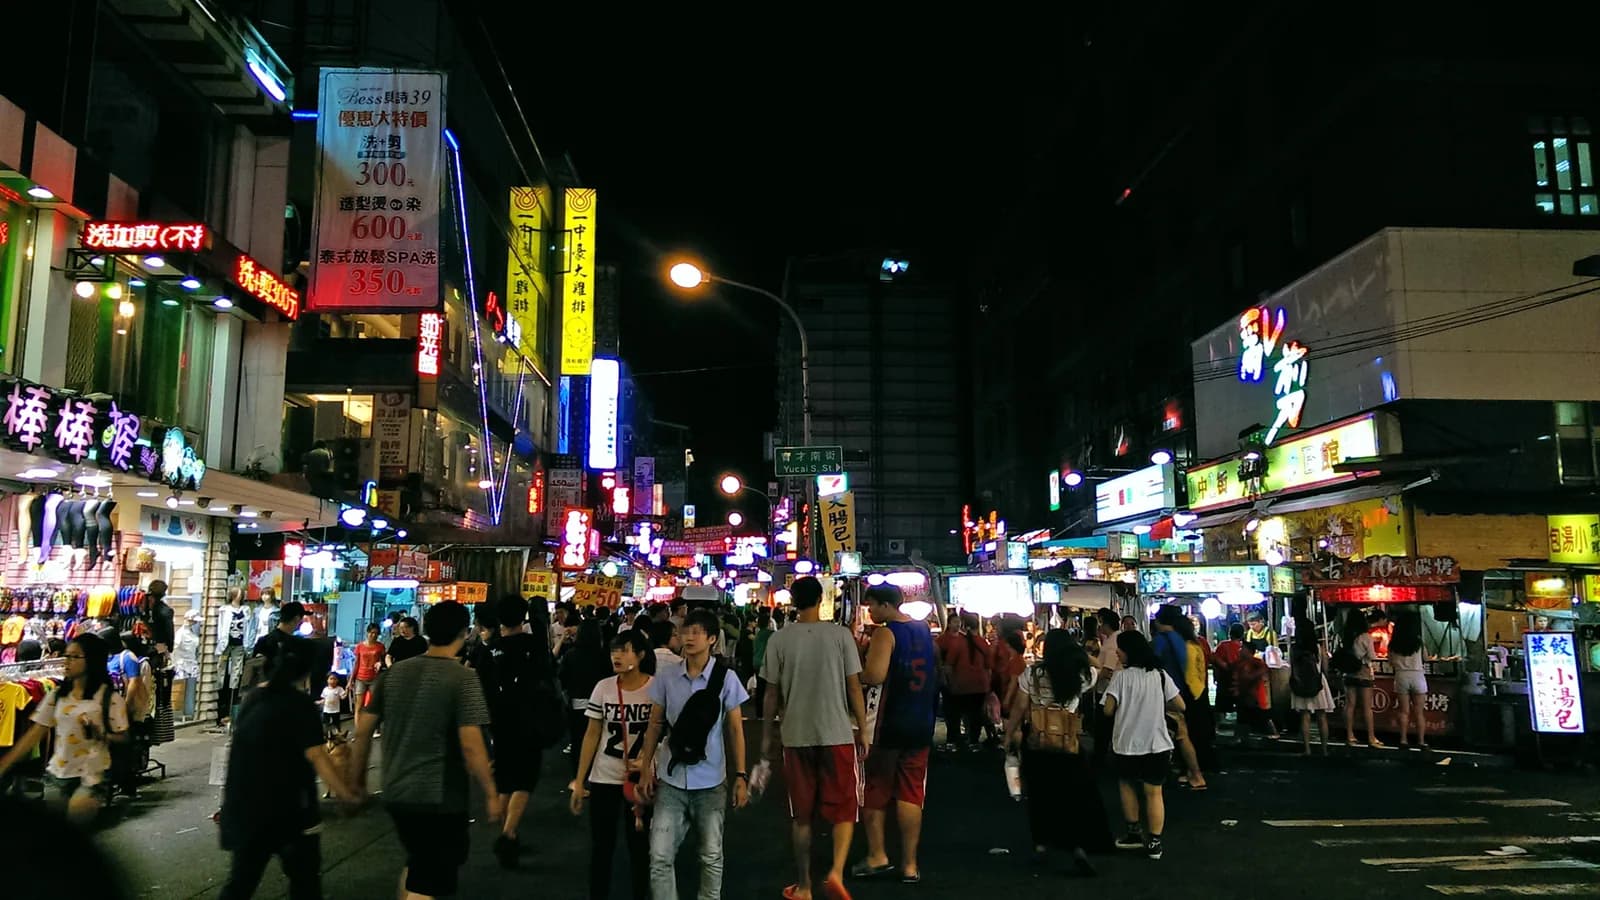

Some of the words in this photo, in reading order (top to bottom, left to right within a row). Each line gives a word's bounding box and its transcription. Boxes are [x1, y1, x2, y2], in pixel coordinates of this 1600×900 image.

[338, 110, 427, 127] 優惠大特價
[361, 134, 402, 149] 洗+剪
[781, 451, 836, 462] 育才南街
[783, 465, 808, 473] Yucai
[827, 496, 852, 553] 大腸包小
[1531, 636, 1573, 657] 蒸餃
[909, 658, 927, 691] 5
[1550, 667, 1580, 730] 小湯包
[604, 703, 653, 722] FENG
[604, 723, 648, 759] 27
